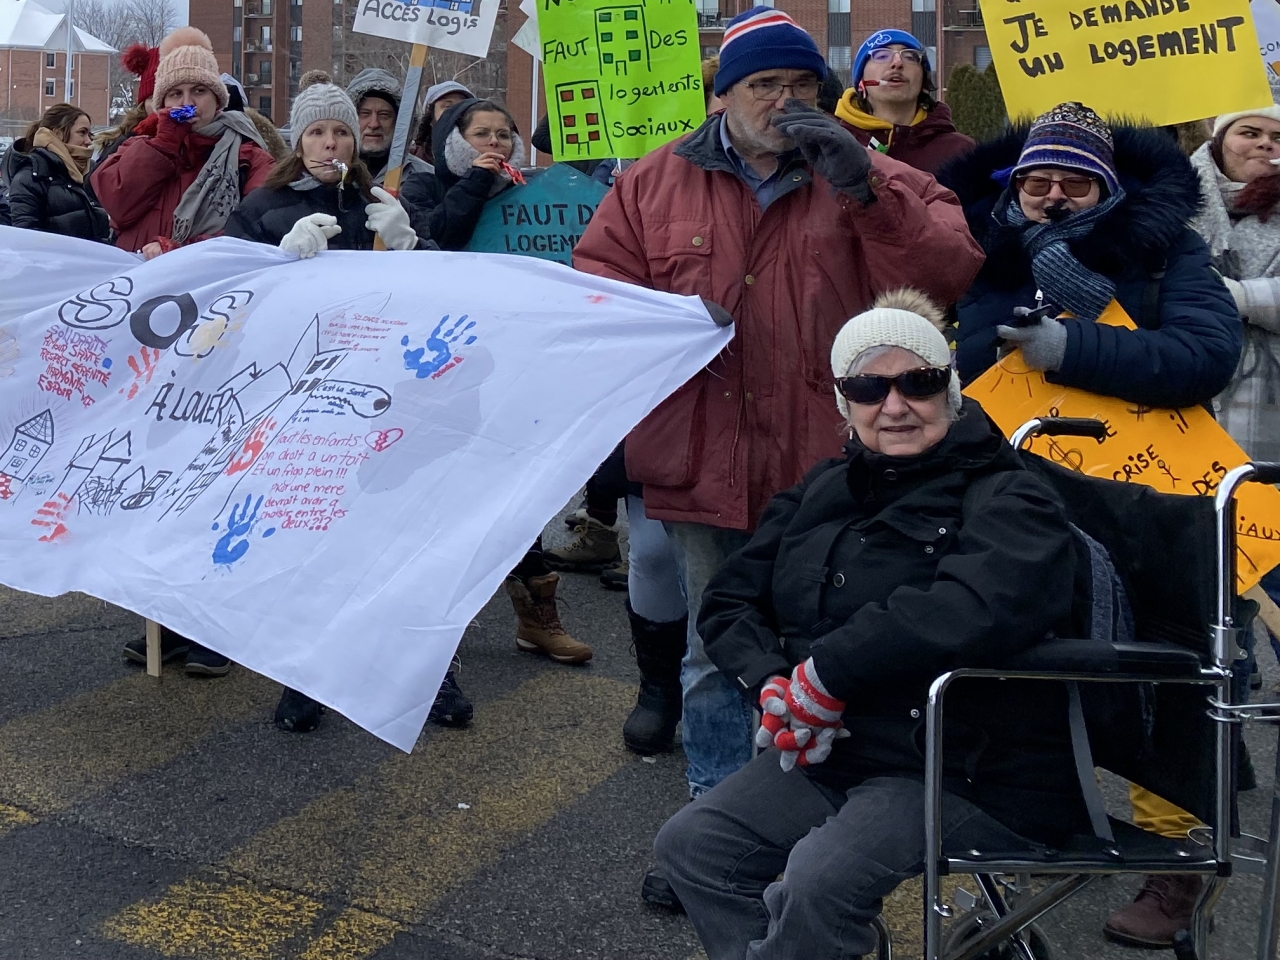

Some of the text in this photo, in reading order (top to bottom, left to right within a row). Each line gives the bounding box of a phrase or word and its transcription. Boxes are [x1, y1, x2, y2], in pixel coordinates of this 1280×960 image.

[1003, 12, 1048, 53] JE
[543, 37, 589, 64] FAUT
[1019, 51, 1064, 78] UN
[501, 203, 600, 226] FAUT D
[58, 276, 254, 359] SOS
[170, 387, 234, 428] LOUER
[312, 432, 361, 447] enfants
[278, 448, 305, 461] droit
[320, 453, 338, 463] un
[338, 451, 370, 466] toit
[251, 461, 268, 476] Et
[267, 467, 280, 477] un
[281, 463, 303, 486] frigo
[304, 466, 333, 478] plein
[1191, 461, 1228, 496] DES
[290, 482, 310, 493] une
[264, 495, 299, 508] devrait
[295, 507, 327, 518] entre
[330, 507, 348, 518] les
